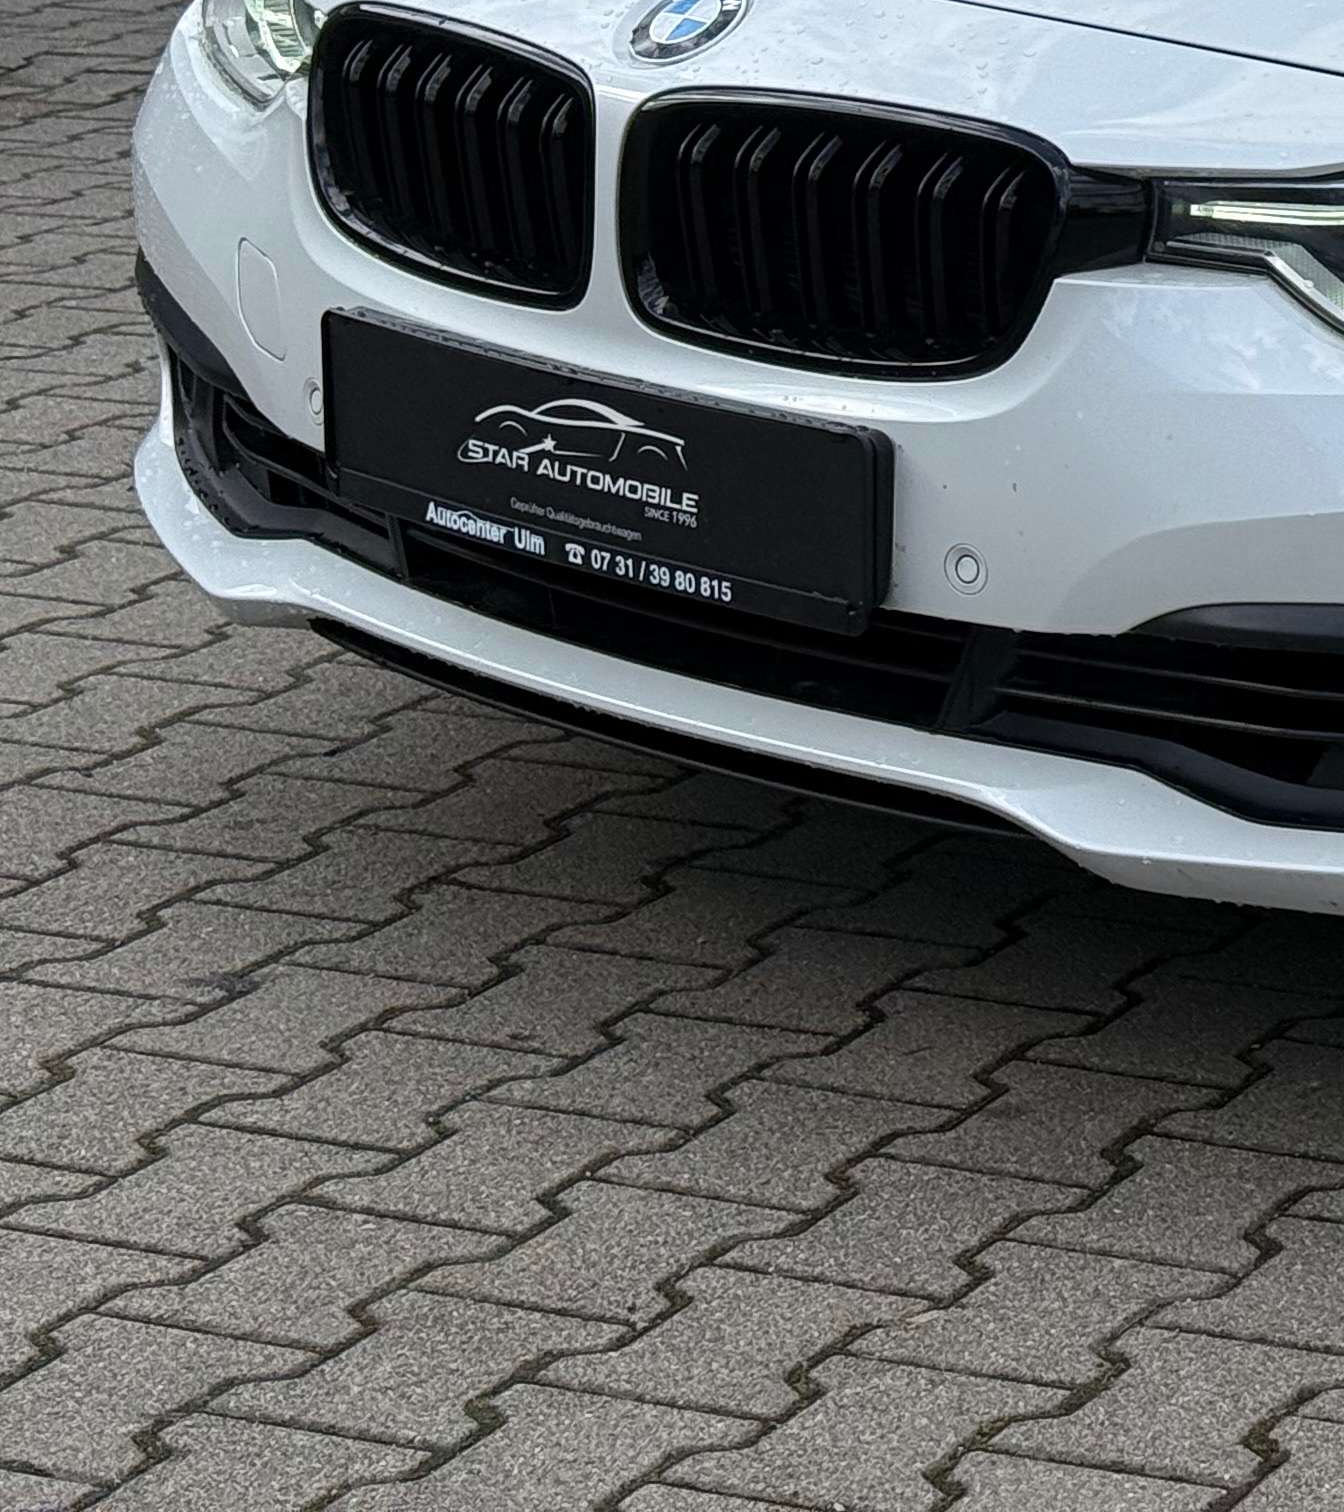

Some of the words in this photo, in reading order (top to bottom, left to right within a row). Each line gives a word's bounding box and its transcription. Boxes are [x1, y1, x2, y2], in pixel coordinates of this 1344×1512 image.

[467, 439, 529, 472] STAR
[536, 458, 699, 513] AUTOMOBILE
[426, 501, 506, 545] Autocenter
[513, 527, 546, 557] Ulm
[590, 548, 611, 571] 07
[615, 554, 635, 578] 31
[638, 559, 647, 581] /
[650, 563, 670, 587] 39
[674, 569, 696, 594] 80
[699, 575, 732, 603] 815
[644, 506, 671, 523] SINCE
[672, 511, 698, 529] 1996
